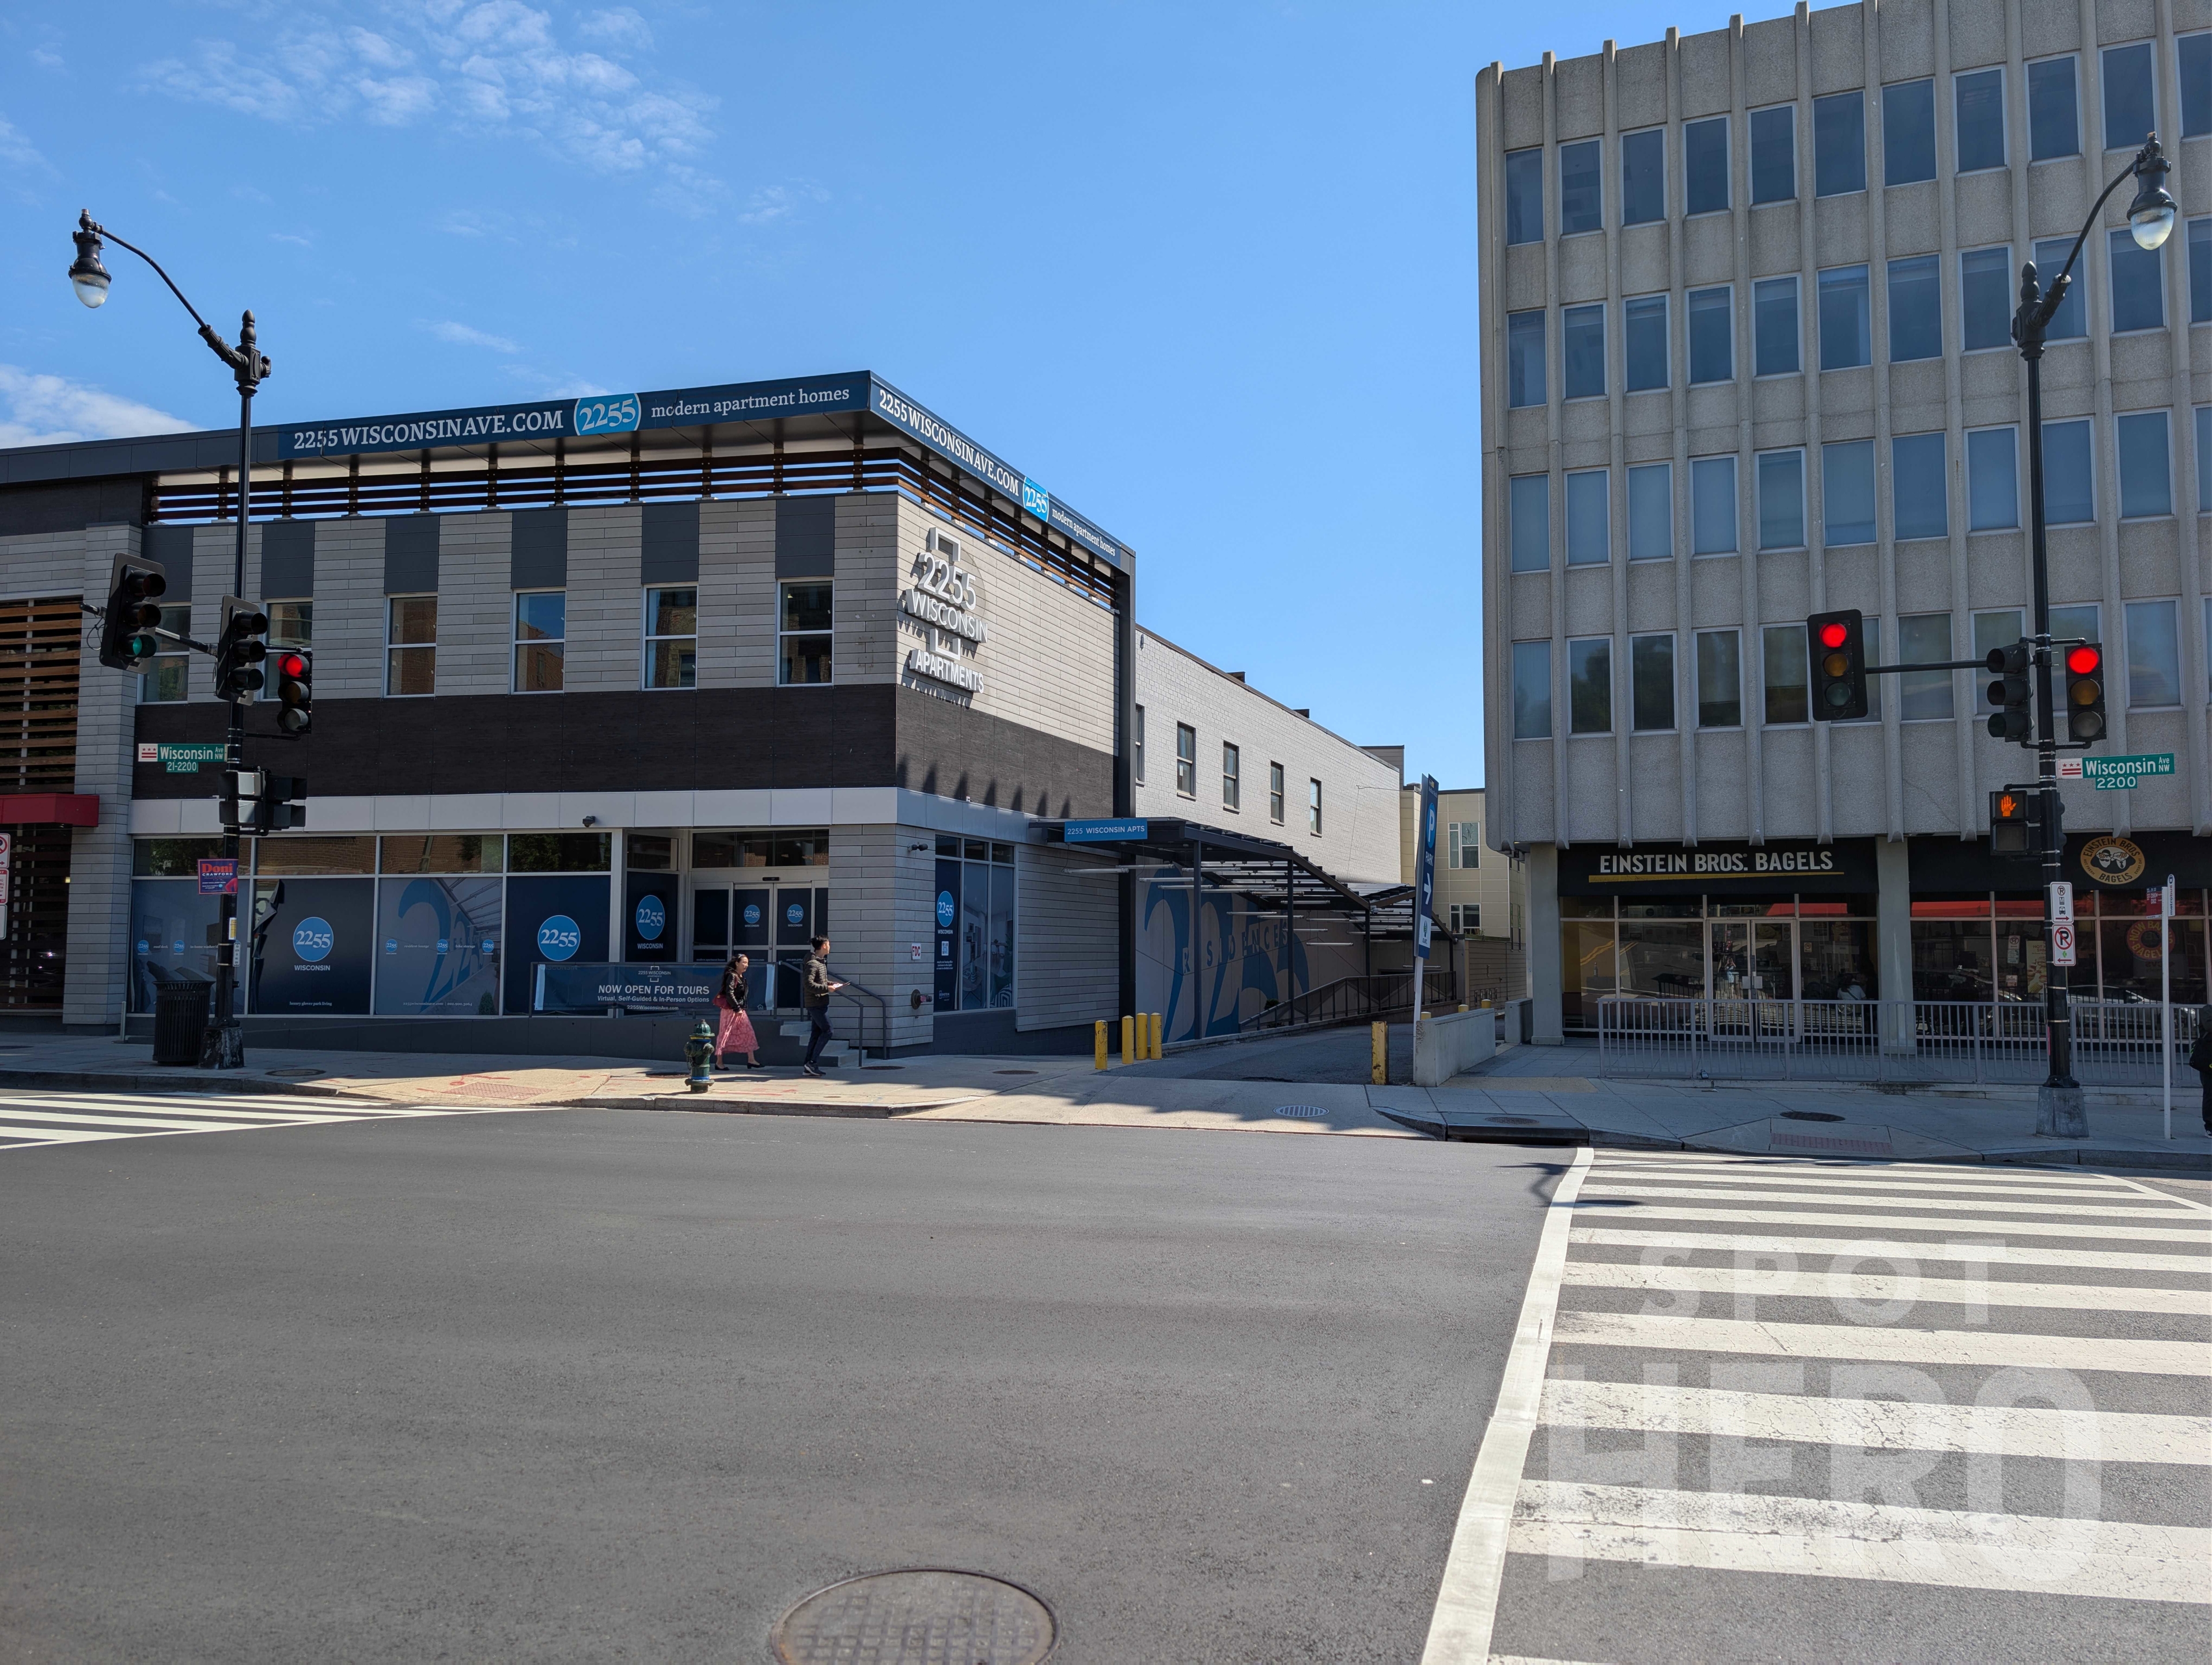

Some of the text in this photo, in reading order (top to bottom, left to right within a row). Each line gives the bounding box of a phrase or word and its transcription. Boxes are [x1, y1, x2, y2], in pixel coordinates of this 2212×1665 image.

[651, 386, 850, 419] modern apartment homes
[579, 397, 636, 428] 2255
[1025, 487, 1047, 513] 2255
[1052, 507, 1116, 556] modern apartment homes
[918, 552, 976, 610] 2255
[906, 589, 988, 643] WISCONSIN
[910, 649, 984, 693] APARTMENTS
[160, 746, 213, 760] Wisconsin
[167, 762, 197, 772] 21-2200
[2086, 757, 2171, 776] Wisconsin Ave NW
[2096, 777, 2137, 788] 2200
[1086, 826, 1126, 834] WISCONSIN
[2083, 838, 2140, 857] EINSTEIN BROS
[1425, 851, 1434, 866] PARK
[1600, 854, 1687, 873] EINSTEIN
[1756, 851, 1834, 871] BAGELS
[202, 863, 233, 873] Doni
[2099, 873, 2133, 883] BAGELS
[638, 908, 664, 927] 2255
[745, 910, 760, 918] 2255
[788, 909, 803, 918] 2255
[938, 901, 953, 916] 2255
[296, 930, 331, 949] 2255
[540, 929, 578, 947] 2255
[2130, 921, 2146, 941] NOW
[912, 945, 921, 958] FDC
[1182, 921, 1289, 974] RSIDENCES
[2131, 943, 2162, 958] BAGEL
[599, 985, 710, 995] NOW OPEN FOR TOURS
